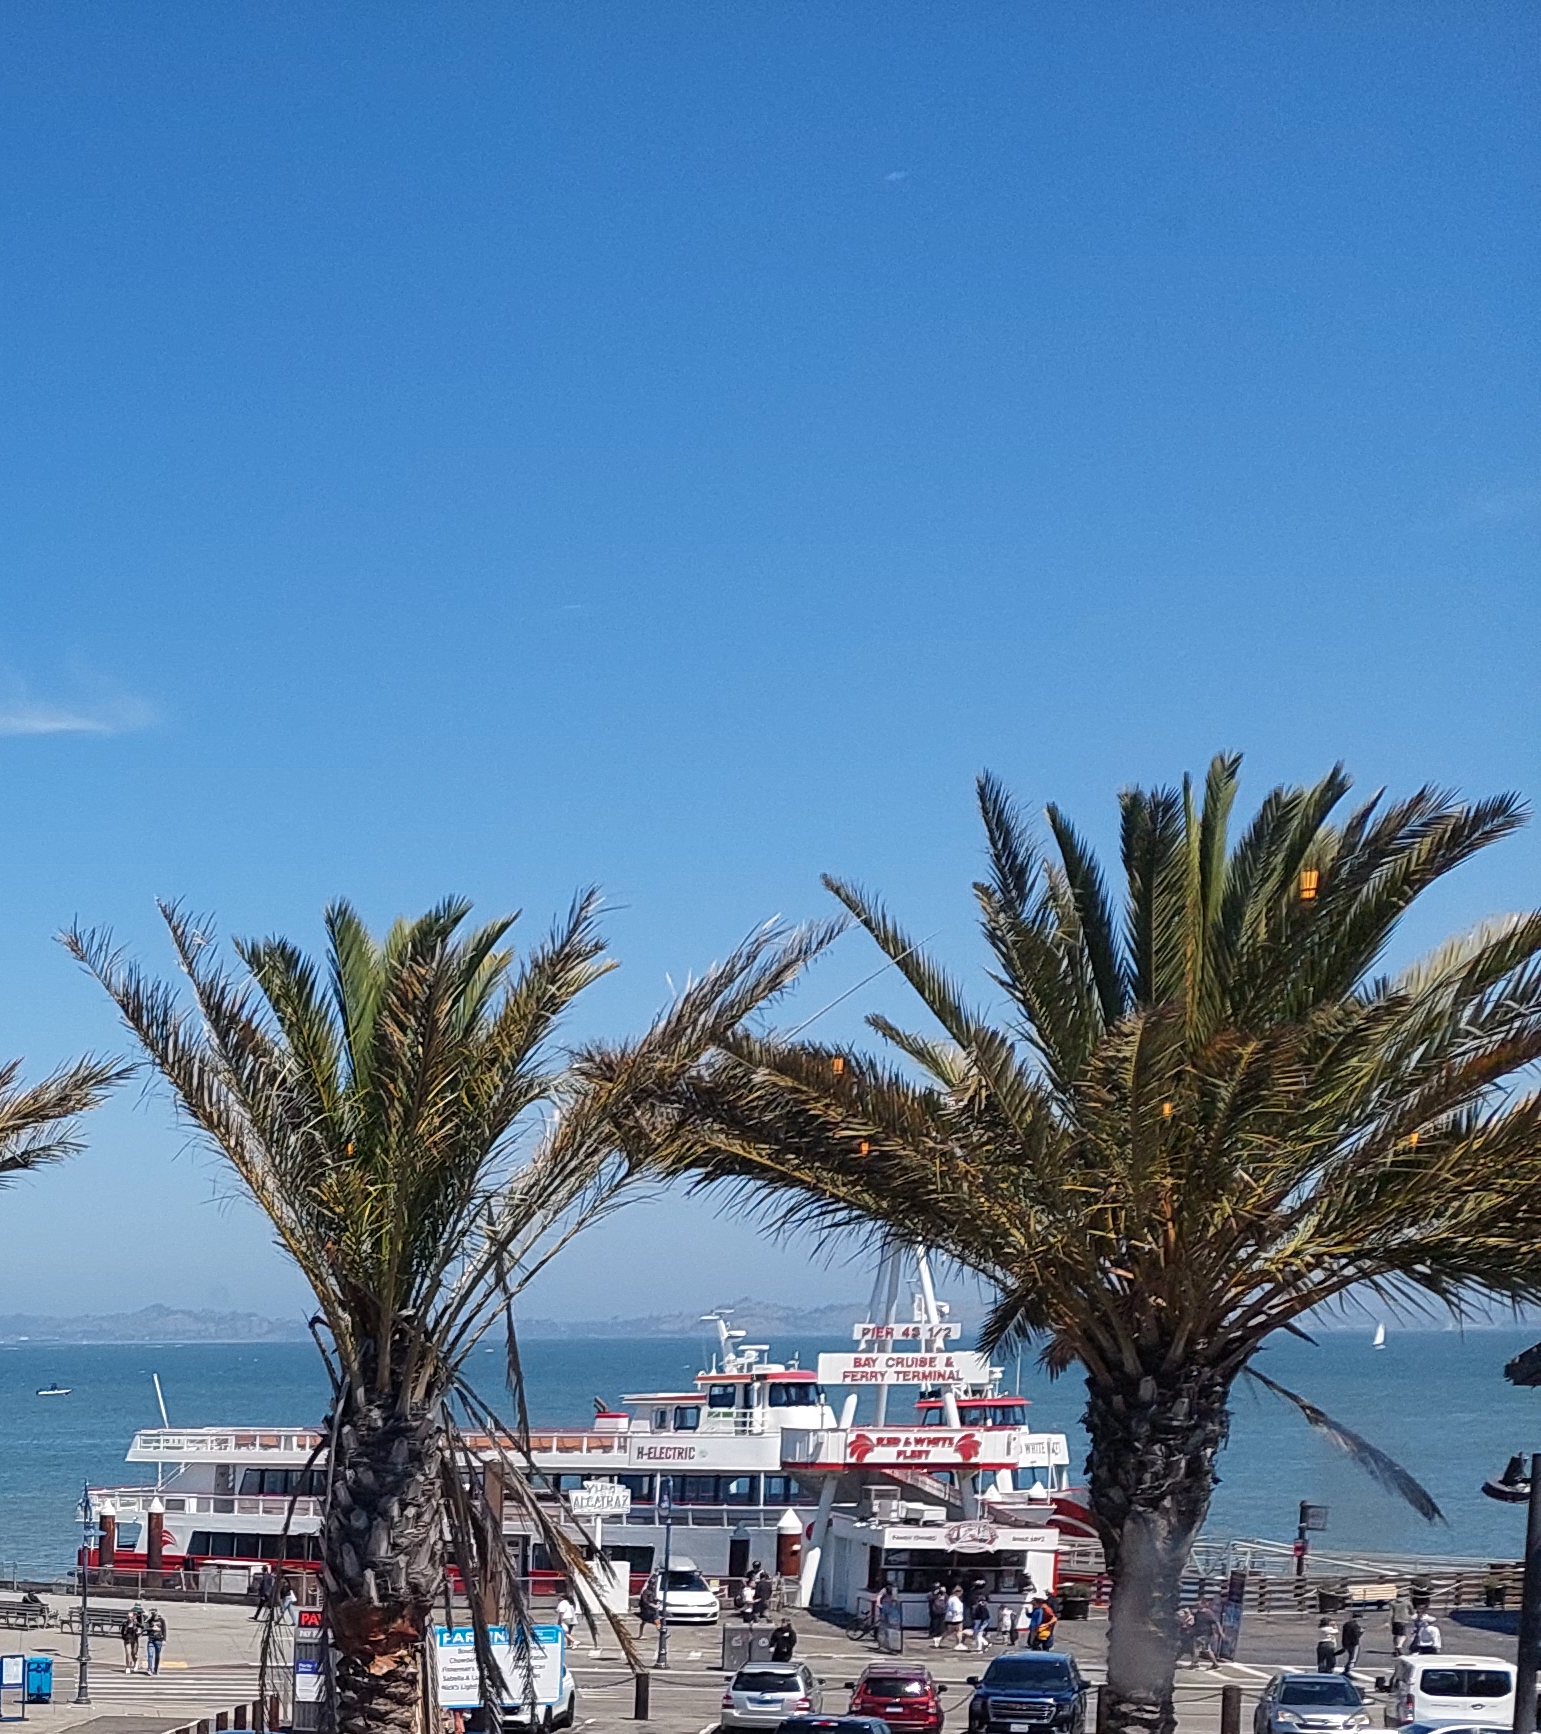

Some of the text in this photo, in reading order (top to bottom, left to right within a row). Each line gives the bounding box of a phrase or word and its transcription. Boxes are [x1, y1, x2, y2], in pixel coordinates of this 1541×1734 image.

[861, 1327, 894, 1339] PIER
[853, 1356, 880, 1368] BAY
[885, 1356, 938, 1368] CRUISE
[842, 1370, 964, 1382] FERRY TERMINAL
[636, 1446, 696, 1460] H-ELECTRIC
[572, 1495, 629, 1509] ALCATRAZ
